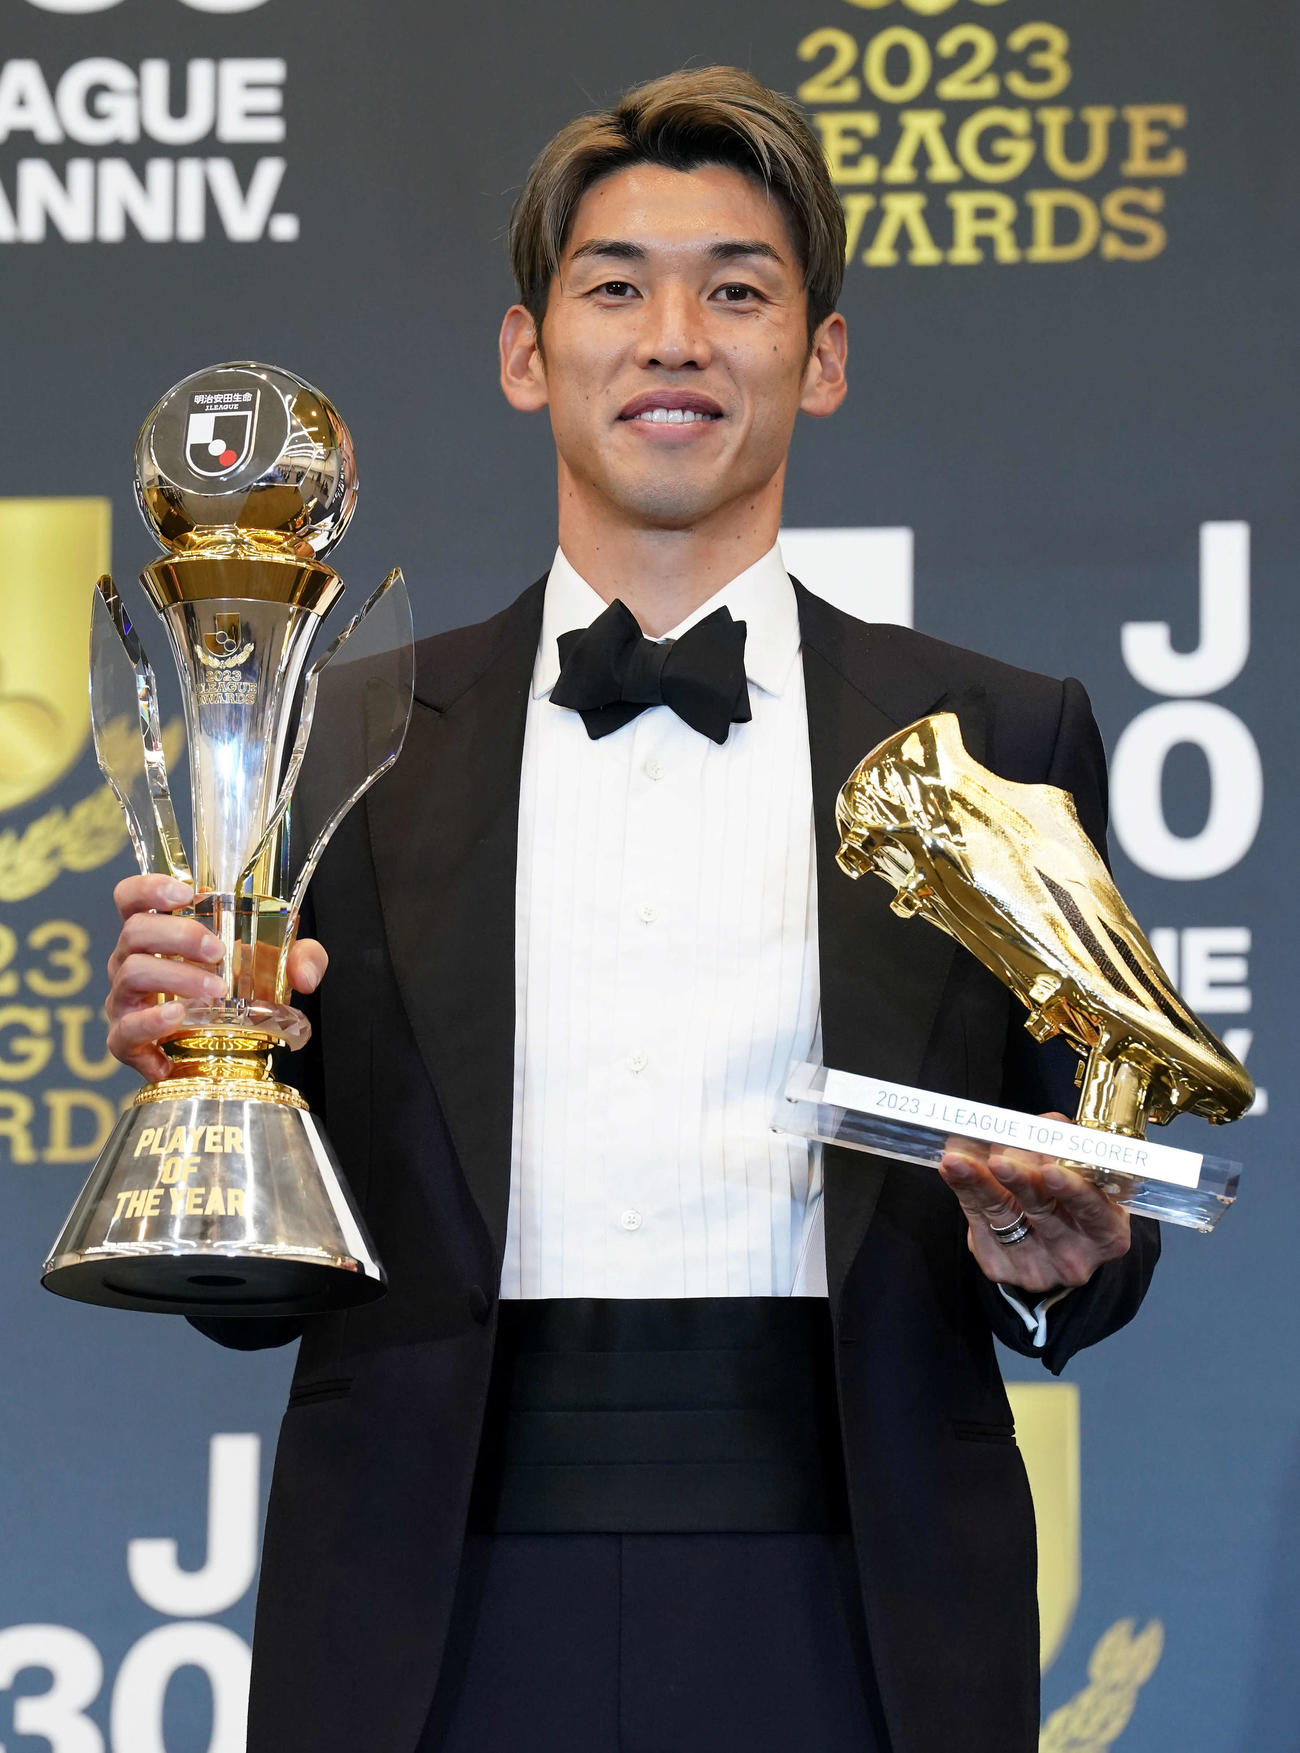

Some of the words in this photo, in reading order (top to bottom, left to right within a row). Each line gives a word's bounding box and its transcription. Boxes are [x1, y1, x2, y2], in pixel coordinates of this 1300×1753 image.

[797, 23, 1072, 103] 2023
[0, 57, 288, 146] AGUE
[193, 392, 252, 404] 明治安田生命
[1121, 519, 1251, 698] J
[206, 670, 241, 681] 2023
[133, 1125, 246, 1158] PLAYER
[876, 1090, 921, 1115] 2023
[926, 1102, 1021, 1138] J.LEAGUE
[1027, 1124, 1064, 1146] TOP
[1069, 1134, 1149, 1168] SCORER
[161, 1156, 202, 1185] OF
[113, 1188, 165, 1219] THE
[169, 1186, 247, 1217] YEAR
[127, 1432, 262, 1618] J
